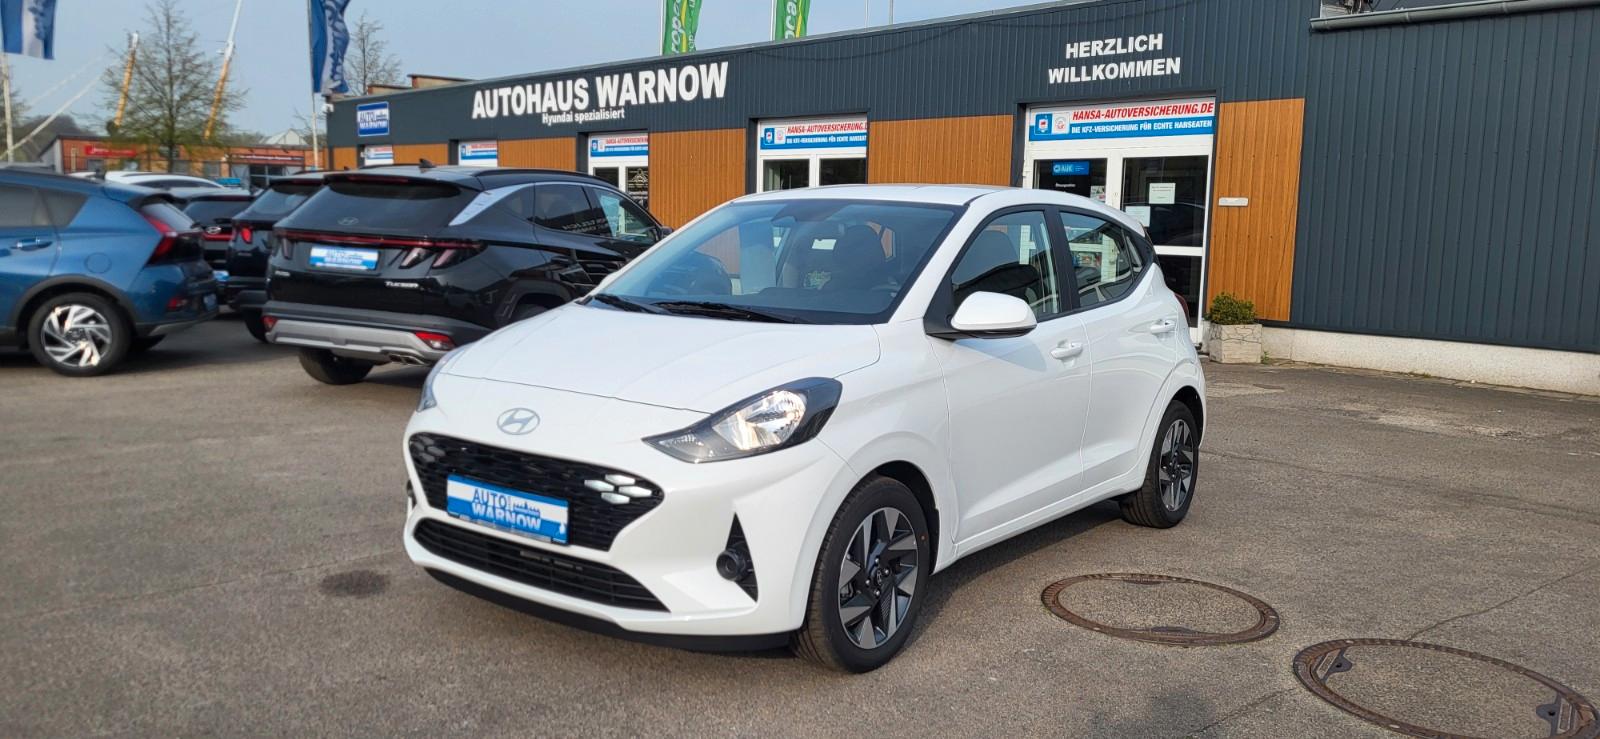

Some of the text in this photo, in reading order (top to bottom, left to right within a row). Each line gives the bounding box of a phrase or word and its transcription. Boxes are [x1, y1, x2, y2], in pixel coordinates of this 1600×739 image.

[1065, 33, 1164, 60] HERZLICH
[1048, 57, 1181, 84] WILLKOMMEN
[472, 61, 729, 119] AUTOHAUS WARNOW
[542, 108, 625, 126] Hyundai spezialisiert
[1072, 103, 1215, 121] HANSA-AUTOVERSICHERUNG.DE
[1071, 120, 1213, 134] DIE KFZ-VERSICHERUNG FÜR ECHTE HANSEATEN
[473, 487, 507, 510] AUTO
[471, 502, 541, 531] WARNOW
